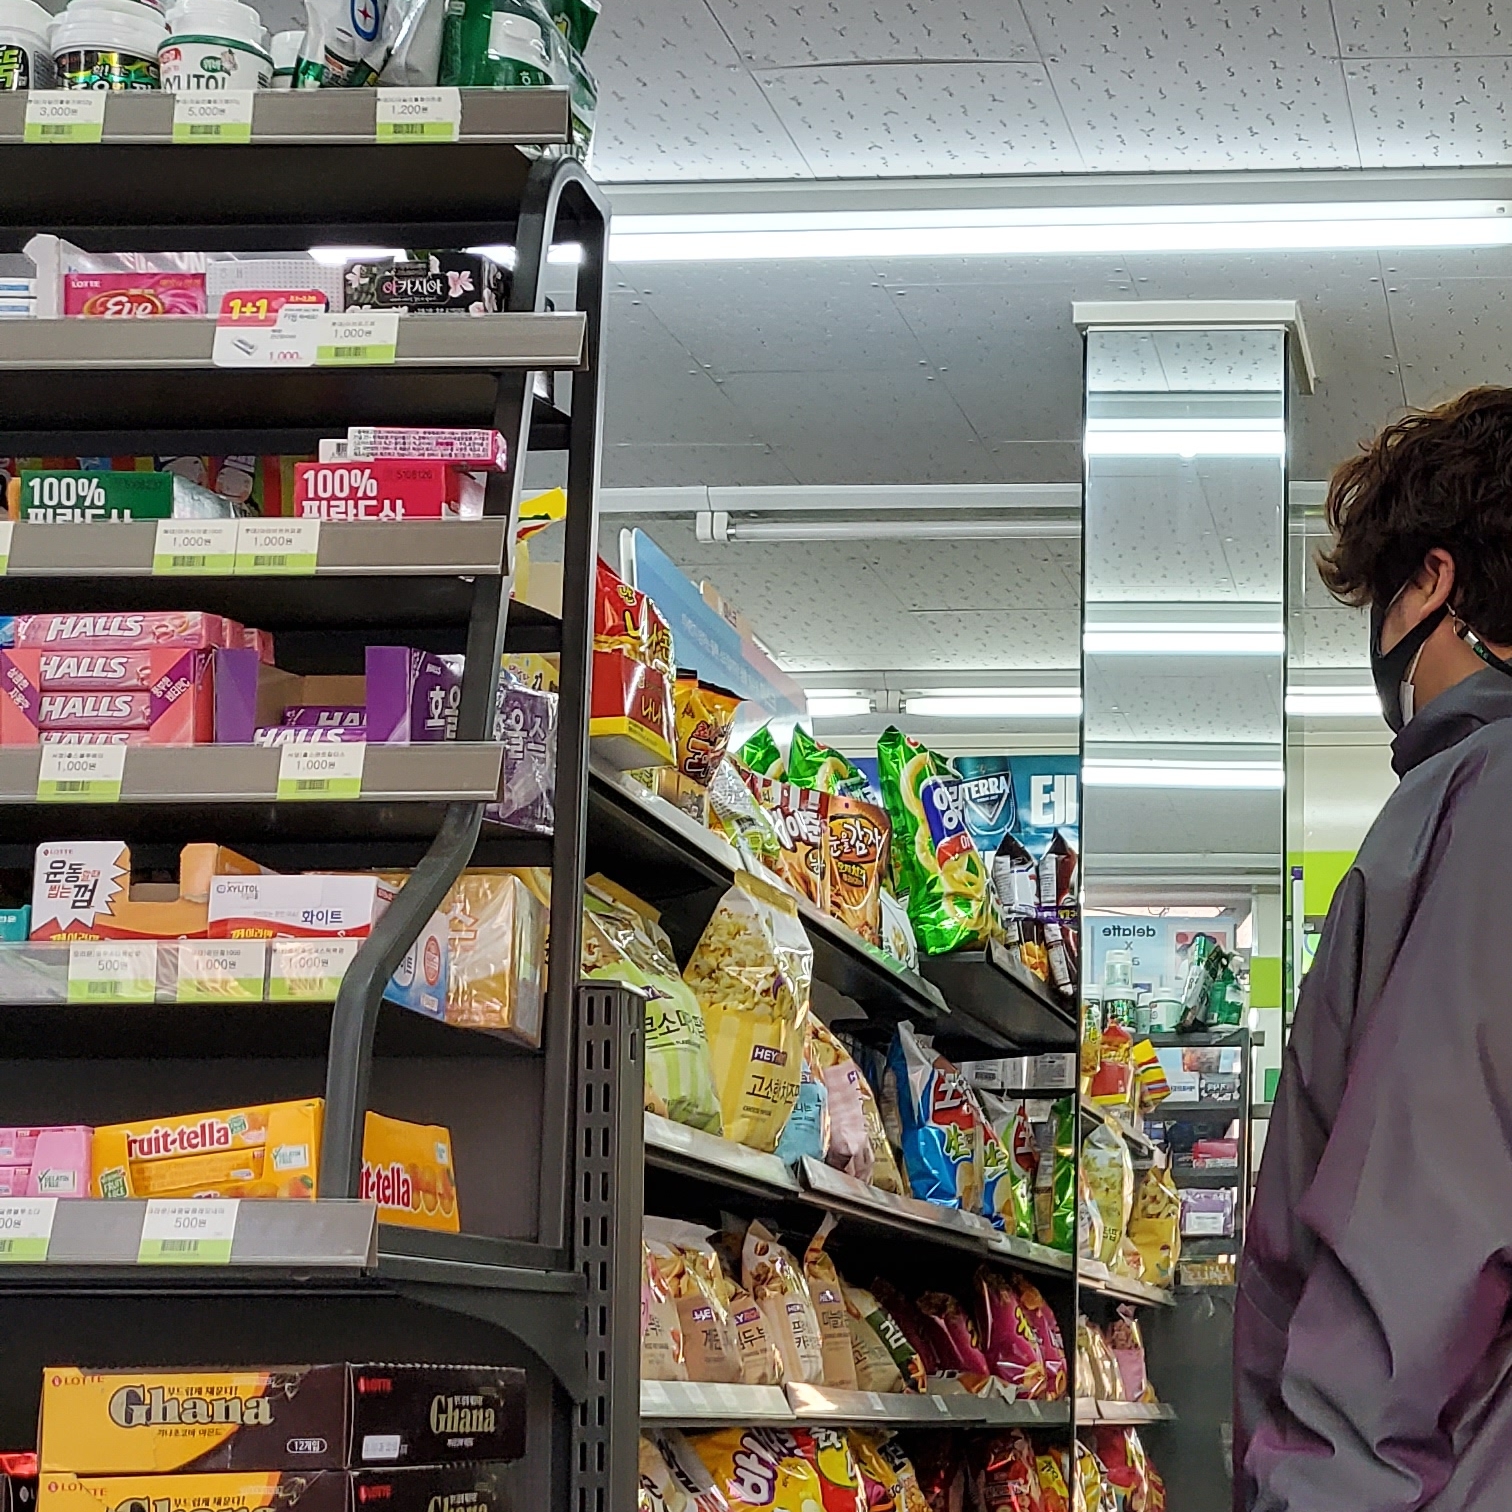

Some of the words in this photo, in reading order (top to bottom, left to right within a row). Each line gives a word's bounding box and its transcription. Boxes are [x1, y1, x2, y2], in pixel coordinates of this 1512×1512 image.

[71, 279, 101, 288] LOTTE
[382, 278, 443, 296] 아카시아
[229, 298, 268, 321] 1+1
[28, 477, 106, 507] 100%
[302, 468, 378, 499] 100%
[45, 615, 145, 642] HALLS
[40, 655, 129, 680] HALLS
[39, 695, 132, 722] HALLS
[57, 761, 97, 772] 1,000원
[963, 776, 1010, 801] TERRA
[829, 821, 882, 857] 눈을감자
[71, 878, 99, 910] 껌
[227, 884, 258, 894] XYLITOL
[301, 909, 343, 925] 화이트
[174, 1217, 206, 1230] 500원
[64, 1375, 105, 1387] LOTTE
[108, 1384, 276, 1429] Ghana
[429, 1394, 496, 1435] Ghana
[292, 1440, 321, 1452] 12개입
[61, 1482, 107, 1497] LOTTE
